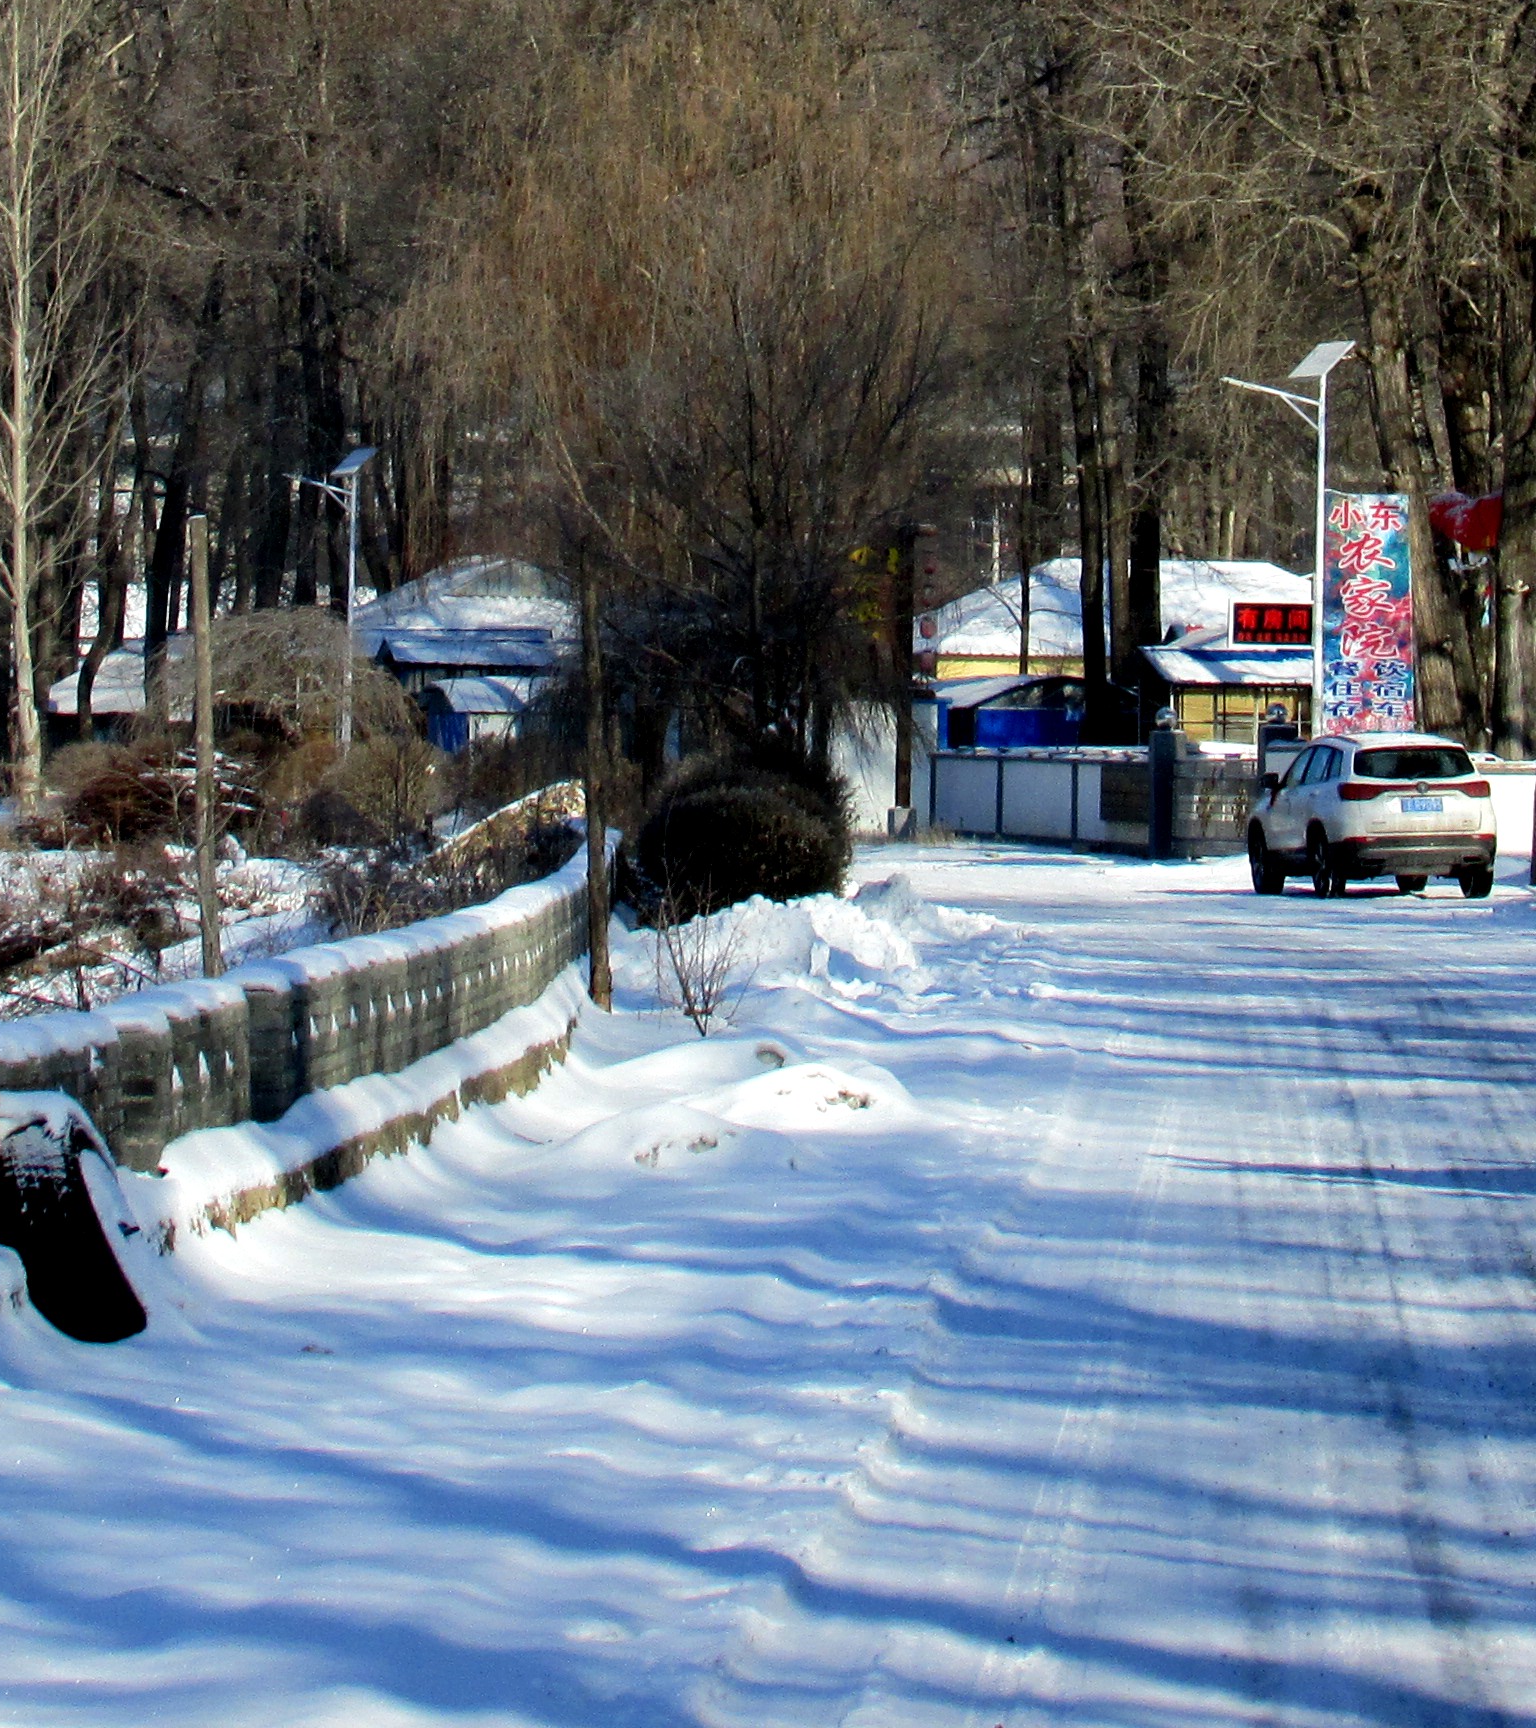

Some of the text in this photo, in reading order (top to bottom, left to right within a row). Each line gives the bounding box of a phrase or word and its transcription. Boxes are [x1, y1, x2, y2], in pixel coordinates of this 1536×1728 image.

[1329, 499, 1403, 530] 小东
[1338, 531, 1399, 659] 农家院
[1326, 660, 1407, 678] 餐饮
[1326, 680, 1407, 697] 住宿
[1326, 700, 1407, 717] 存车
